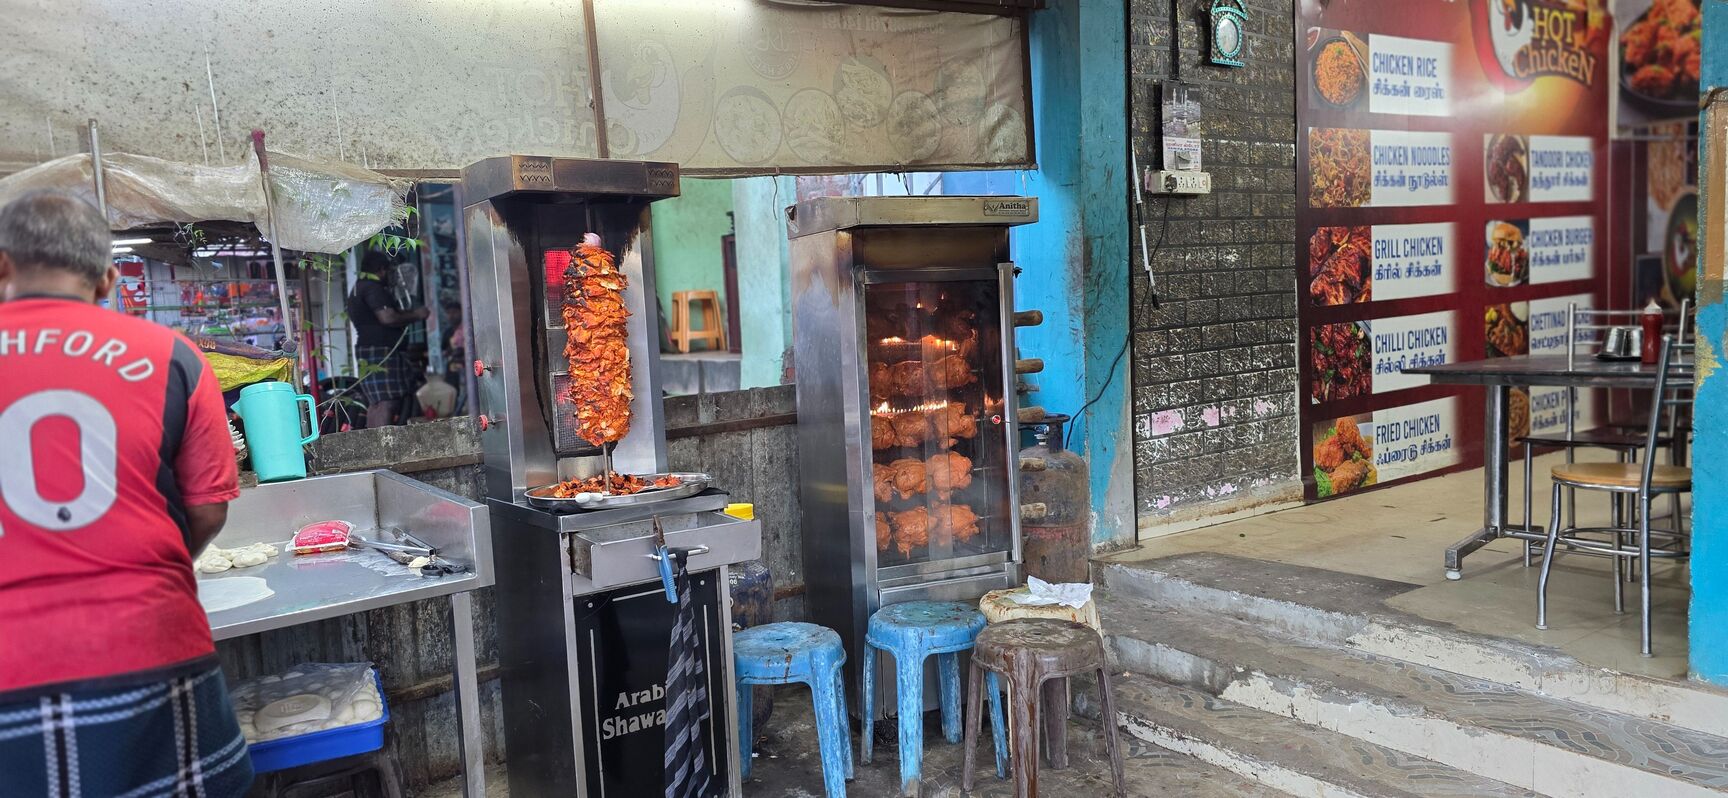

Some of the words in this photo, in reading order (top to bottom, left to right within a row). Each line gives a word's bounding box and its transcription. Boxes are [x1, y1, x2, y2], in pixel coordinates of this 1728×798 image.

[1533, 6, 1574, 43] HOT
[1373, 52, 1413, 76] CHICKEN
[1417, 57, 1437, 78] RICE
[1374, 145, 1408, 166] CHICKEN
[1565, 151, 1592, 168] CHICKEN
[1000, 202, 1026, 210] Anitha
[1375, 240, 1401, 259] GRILL
[1404, 236, 1443, 257] CHICKEN
[1531, 229, 1562, 248] CHICKEN
[1566, 228, 1592, 246] BURGER
[1375, 332, 1405, 354] CHILLI
[1408, 326, 1447, 350] CHICKEN
[1532, 392, 1560, 413] CHICKEN
[1376, 422, 1401, 445] FRIED
[1403, 413, 1441, 439] CHICKEN
[615, 683, 667, 710] Arab
